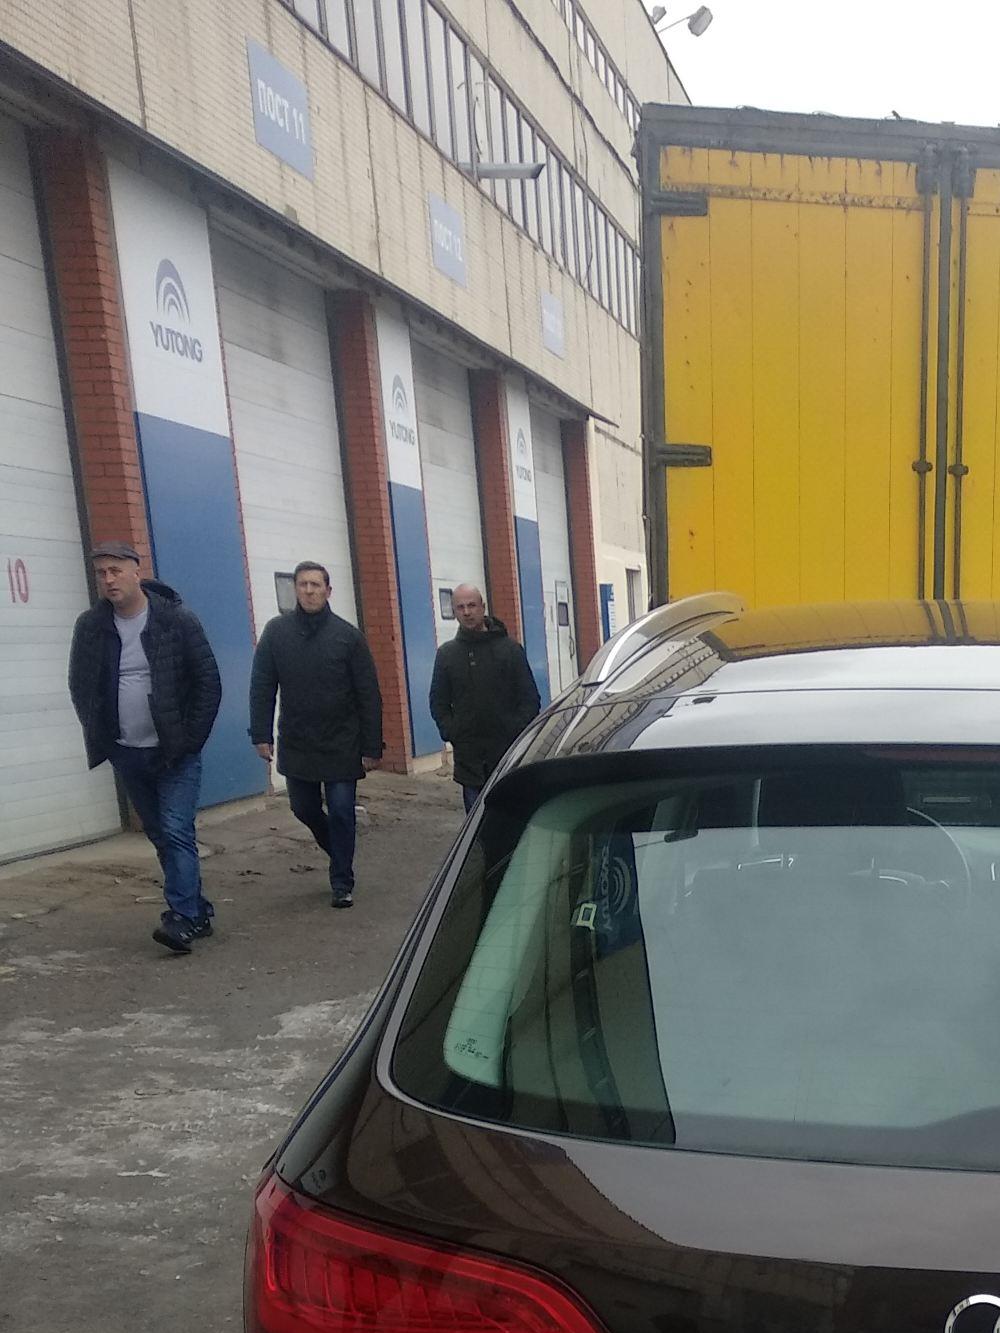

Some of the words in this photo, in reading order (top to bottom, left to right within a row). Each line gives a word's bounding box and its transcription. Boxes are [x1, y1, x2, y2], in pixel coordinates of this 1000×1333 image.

[256, 78, 290, 134] ПОСТ
[149, 320, 203, 363] YUTONG
[389, 419, 416, 446] YUTONG
[7, 557, 29, 604] 10
